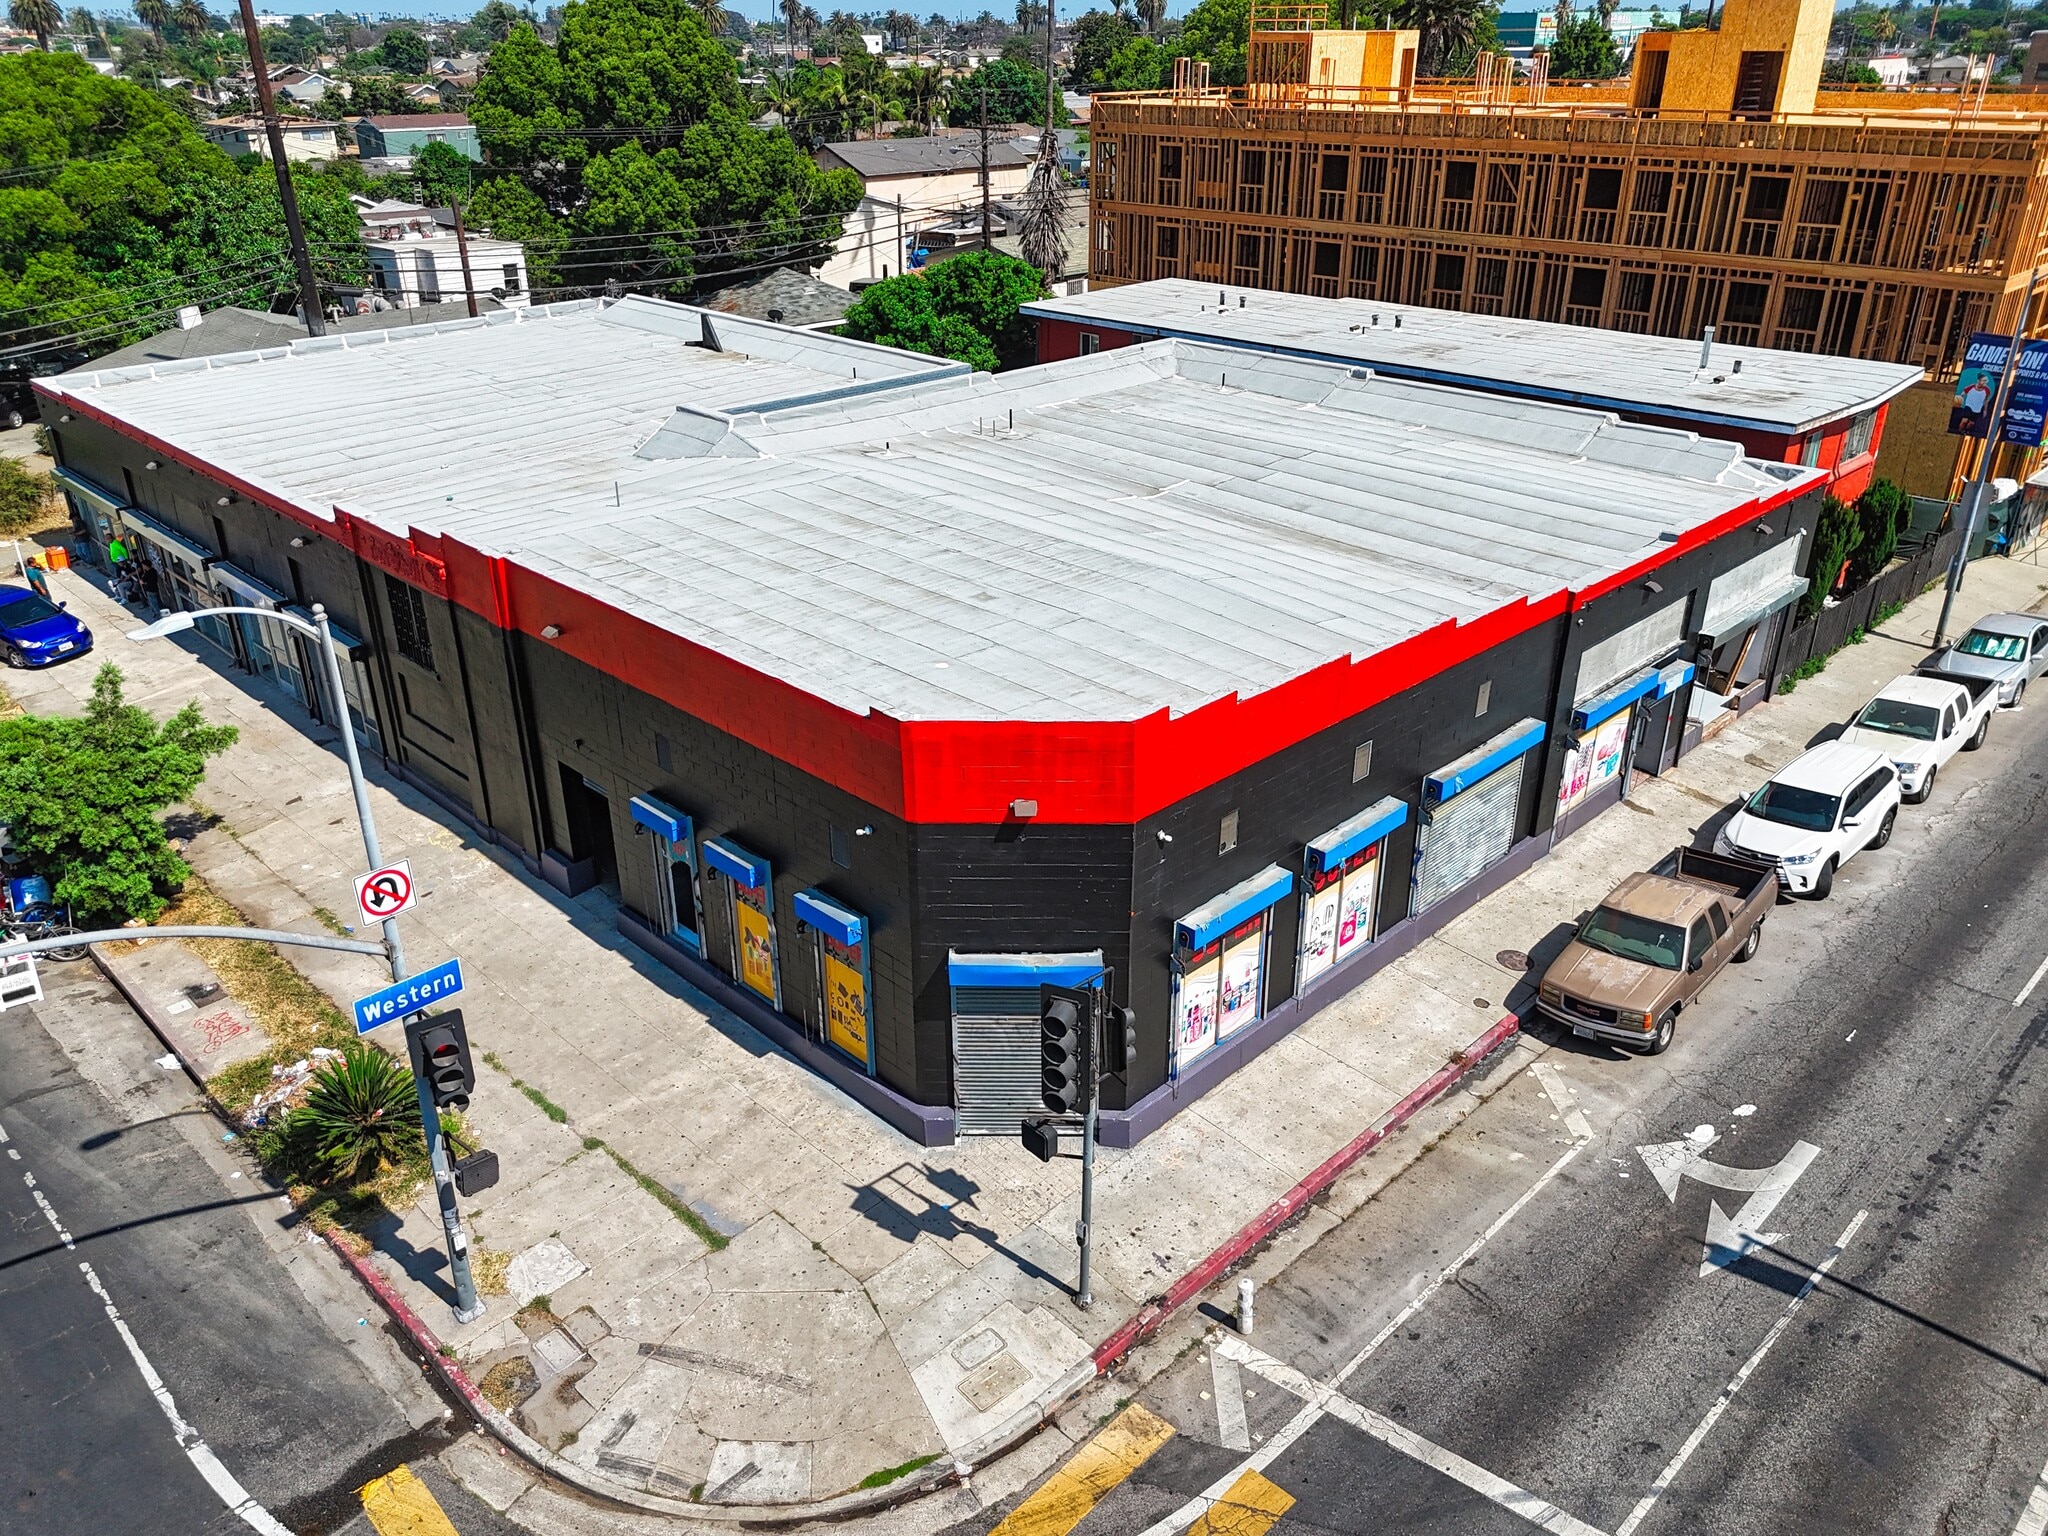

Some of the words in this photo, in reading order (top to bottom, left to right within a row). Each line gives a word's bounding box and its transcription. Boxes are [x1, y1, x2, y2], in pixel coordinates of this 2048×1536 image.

[1966, 343, 2011, 365] GAME
[2018, 350, 2048, 370] ON!
[362, 973, 456, 1023] Western
